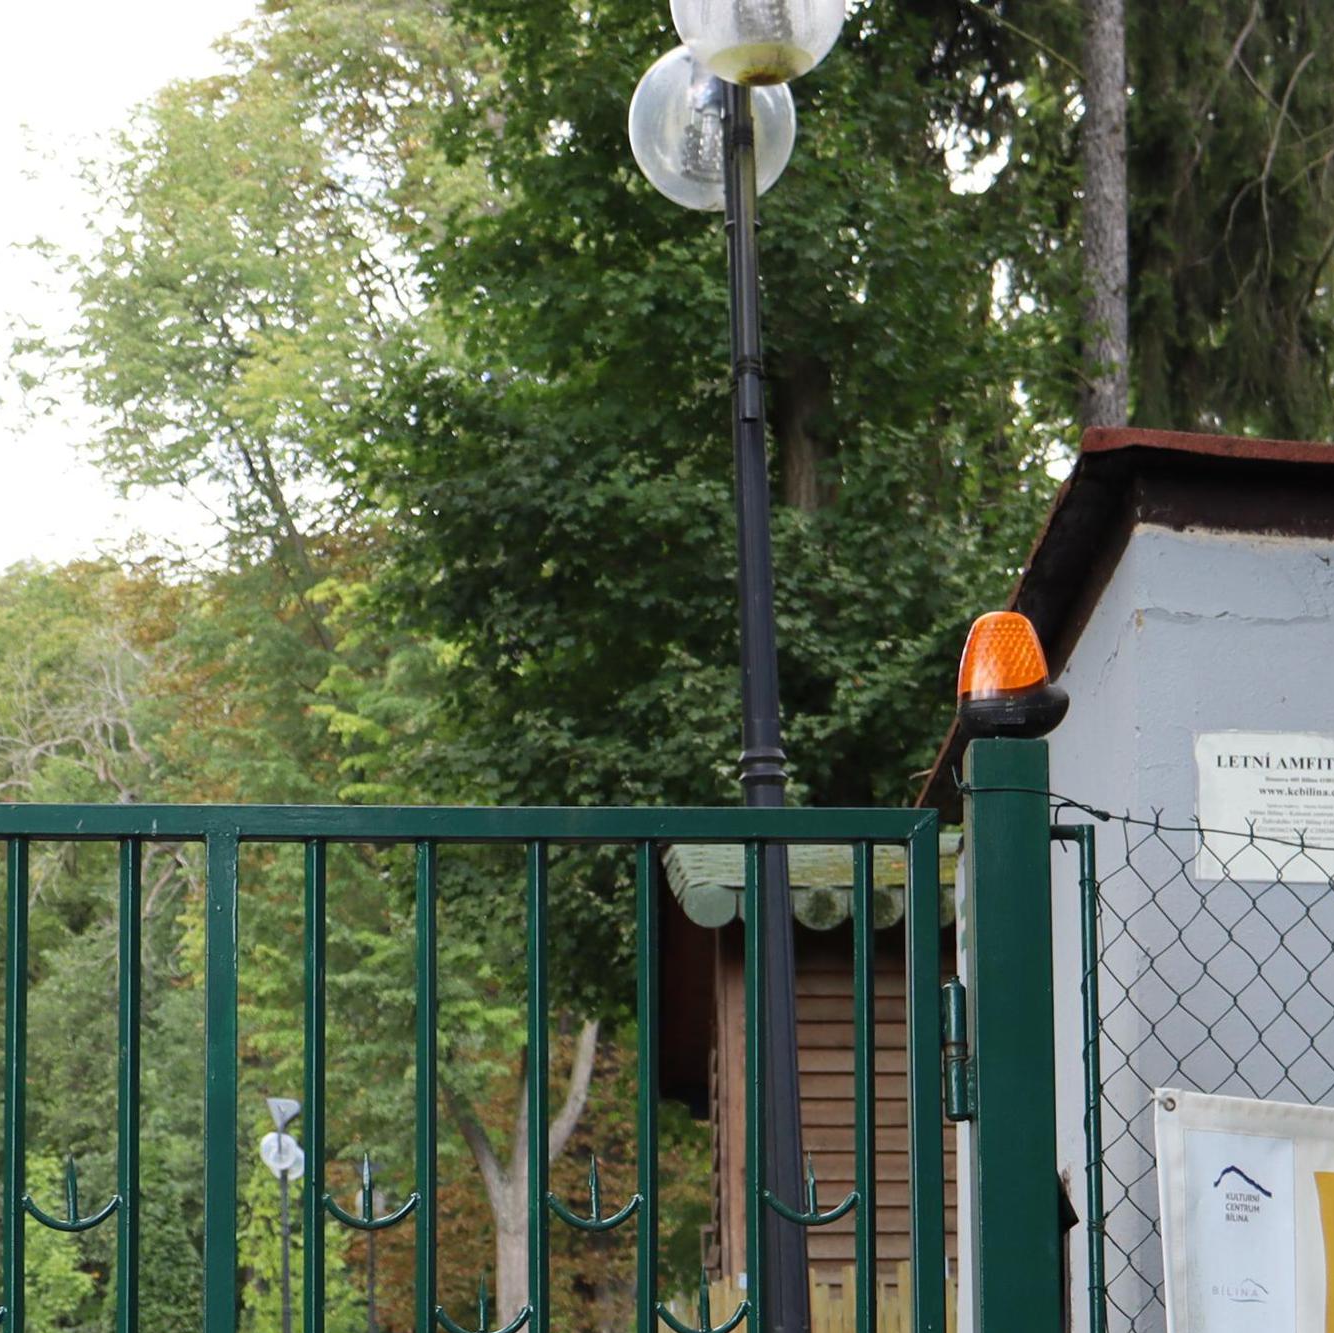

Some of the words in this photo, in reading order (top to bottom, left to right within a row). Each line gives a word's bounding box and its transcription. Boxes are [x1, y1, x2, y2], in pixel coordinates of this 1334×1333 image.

[1216, 752, 1271, 770] LETNÍ
[1225, 1192, 1261, 1203] KULTURNÍ
[1225, 1203, 1261, 1213] CENTRUM
[1225, 1212, 1250, 1223] BÍLINA
